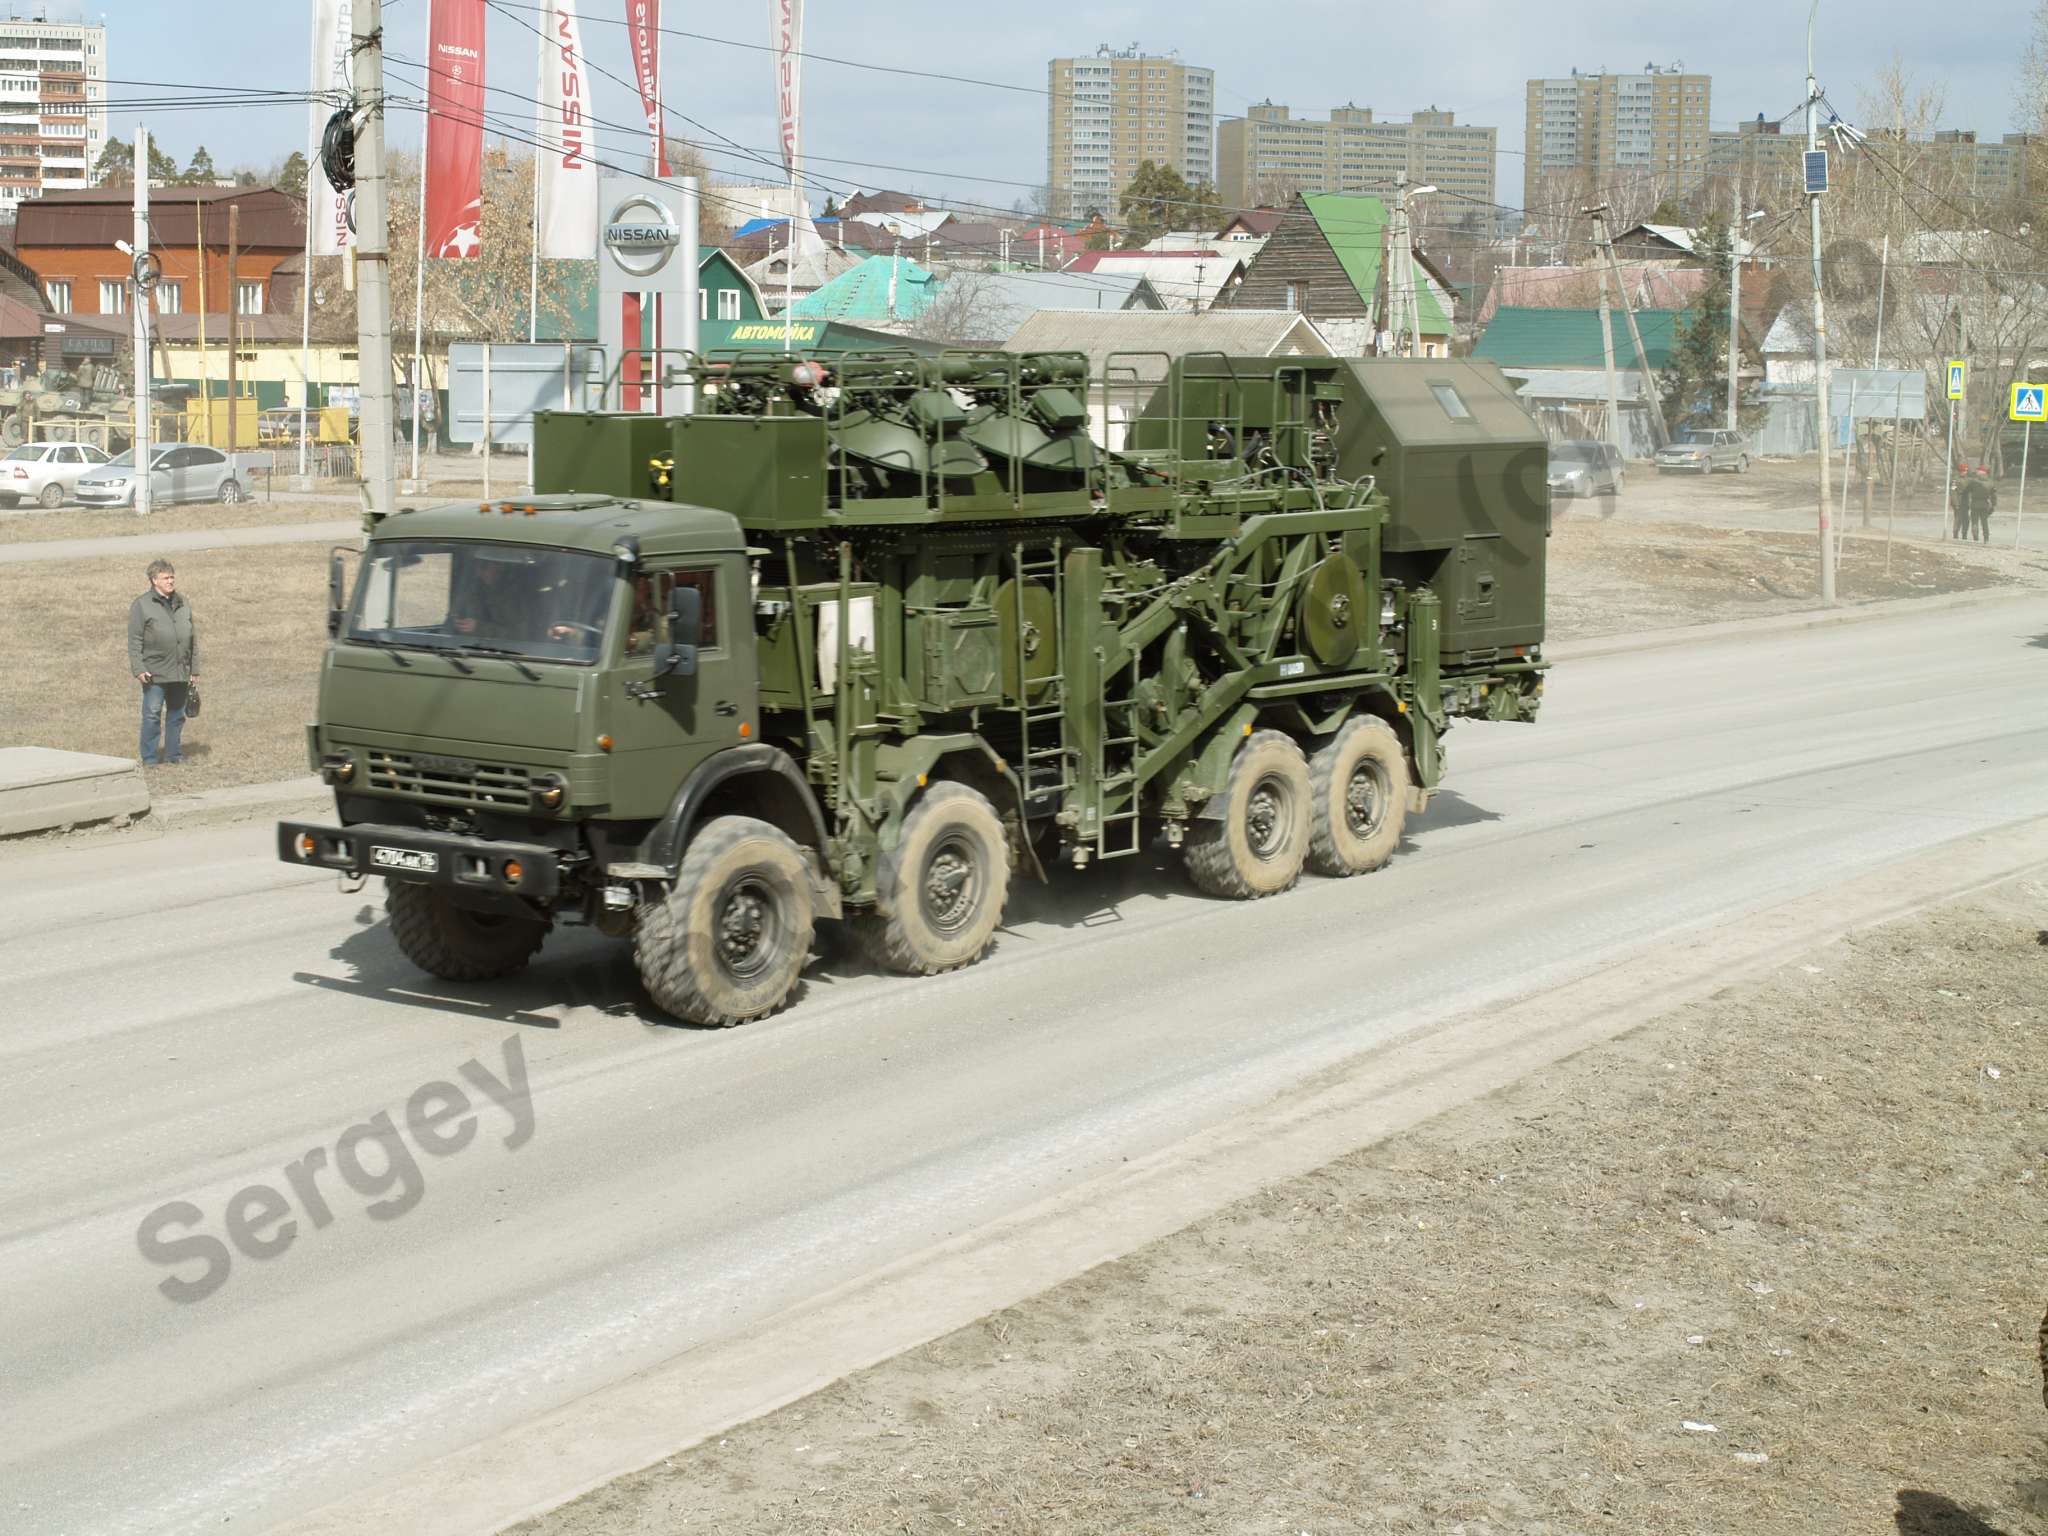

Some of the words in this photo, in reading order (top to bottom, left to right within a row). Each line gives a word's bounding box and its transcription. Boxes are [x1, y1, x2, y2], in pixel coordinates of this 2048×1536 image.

[438, 43, 478, 58] NISSAN
[553, 9, 582, 169] NISSAN
[608, 228, 670, 241] NISSAN
[731, 323, 815, 341] АВТОМОЙКА
